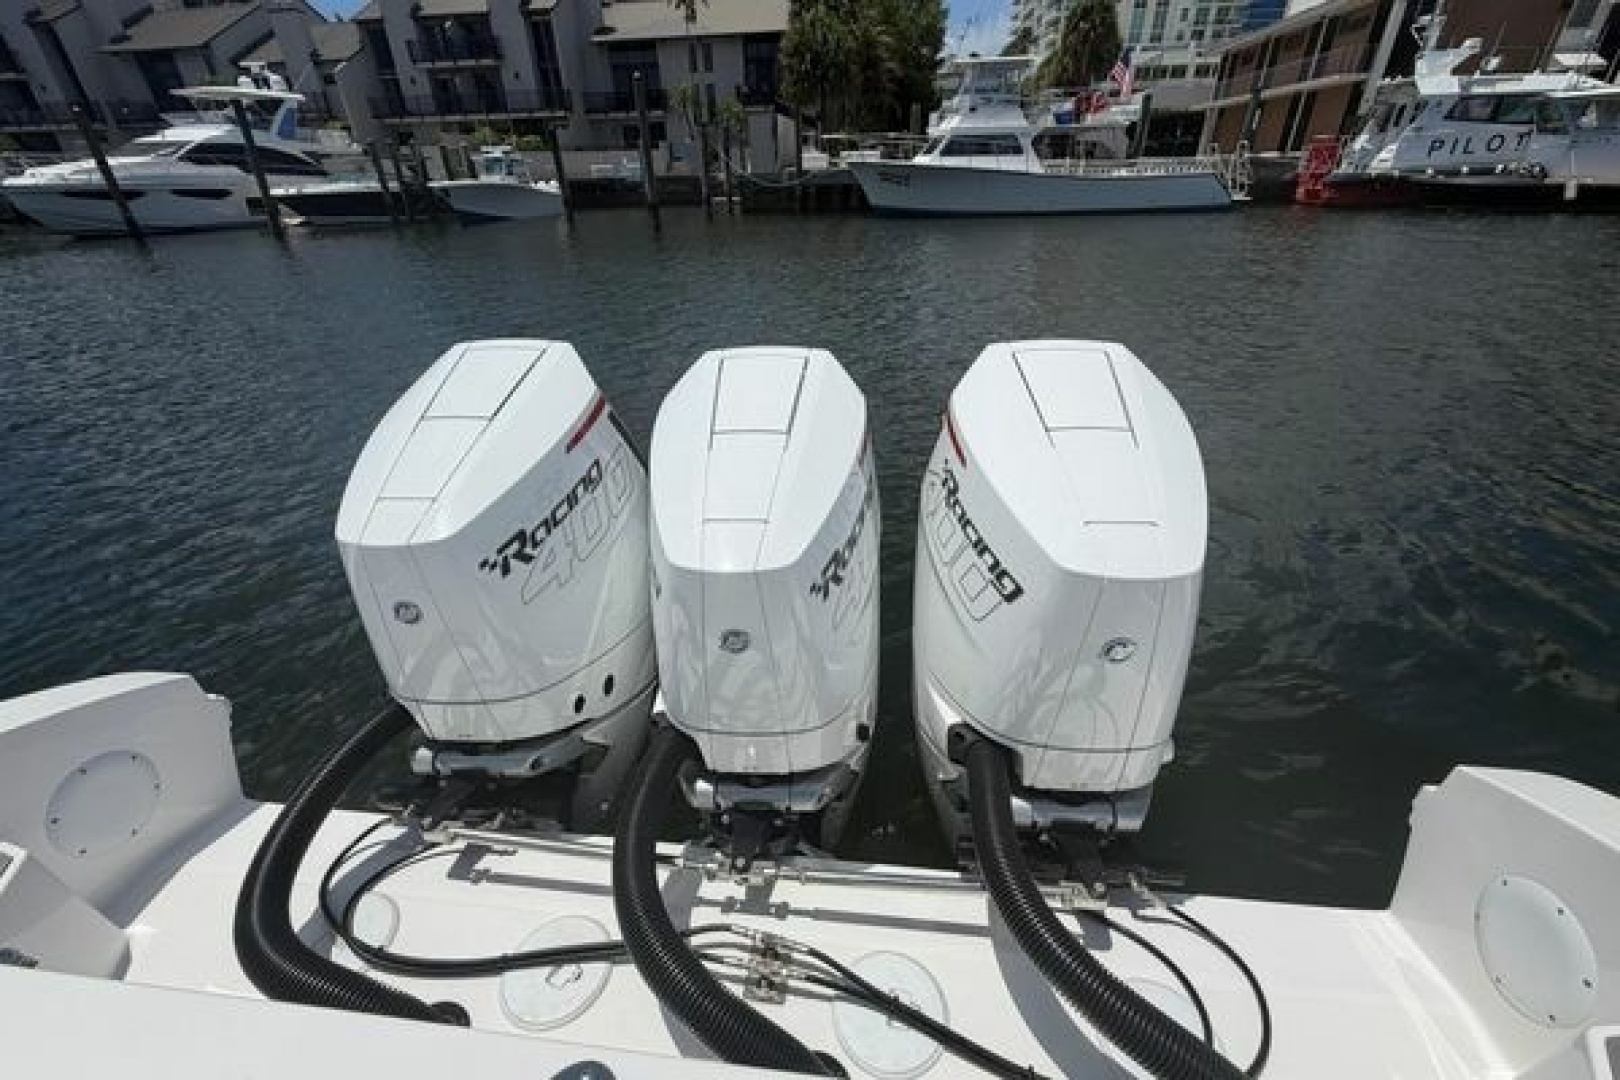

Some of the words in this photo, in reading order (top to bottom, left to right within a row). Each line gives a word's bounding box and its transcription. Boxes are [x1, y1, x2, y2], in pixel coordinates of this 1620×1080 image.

[1427, 129, 1534, 157] PILOT
[494, 458, 603, 578] Racing
[942, 466, 1024, 605] Racing
